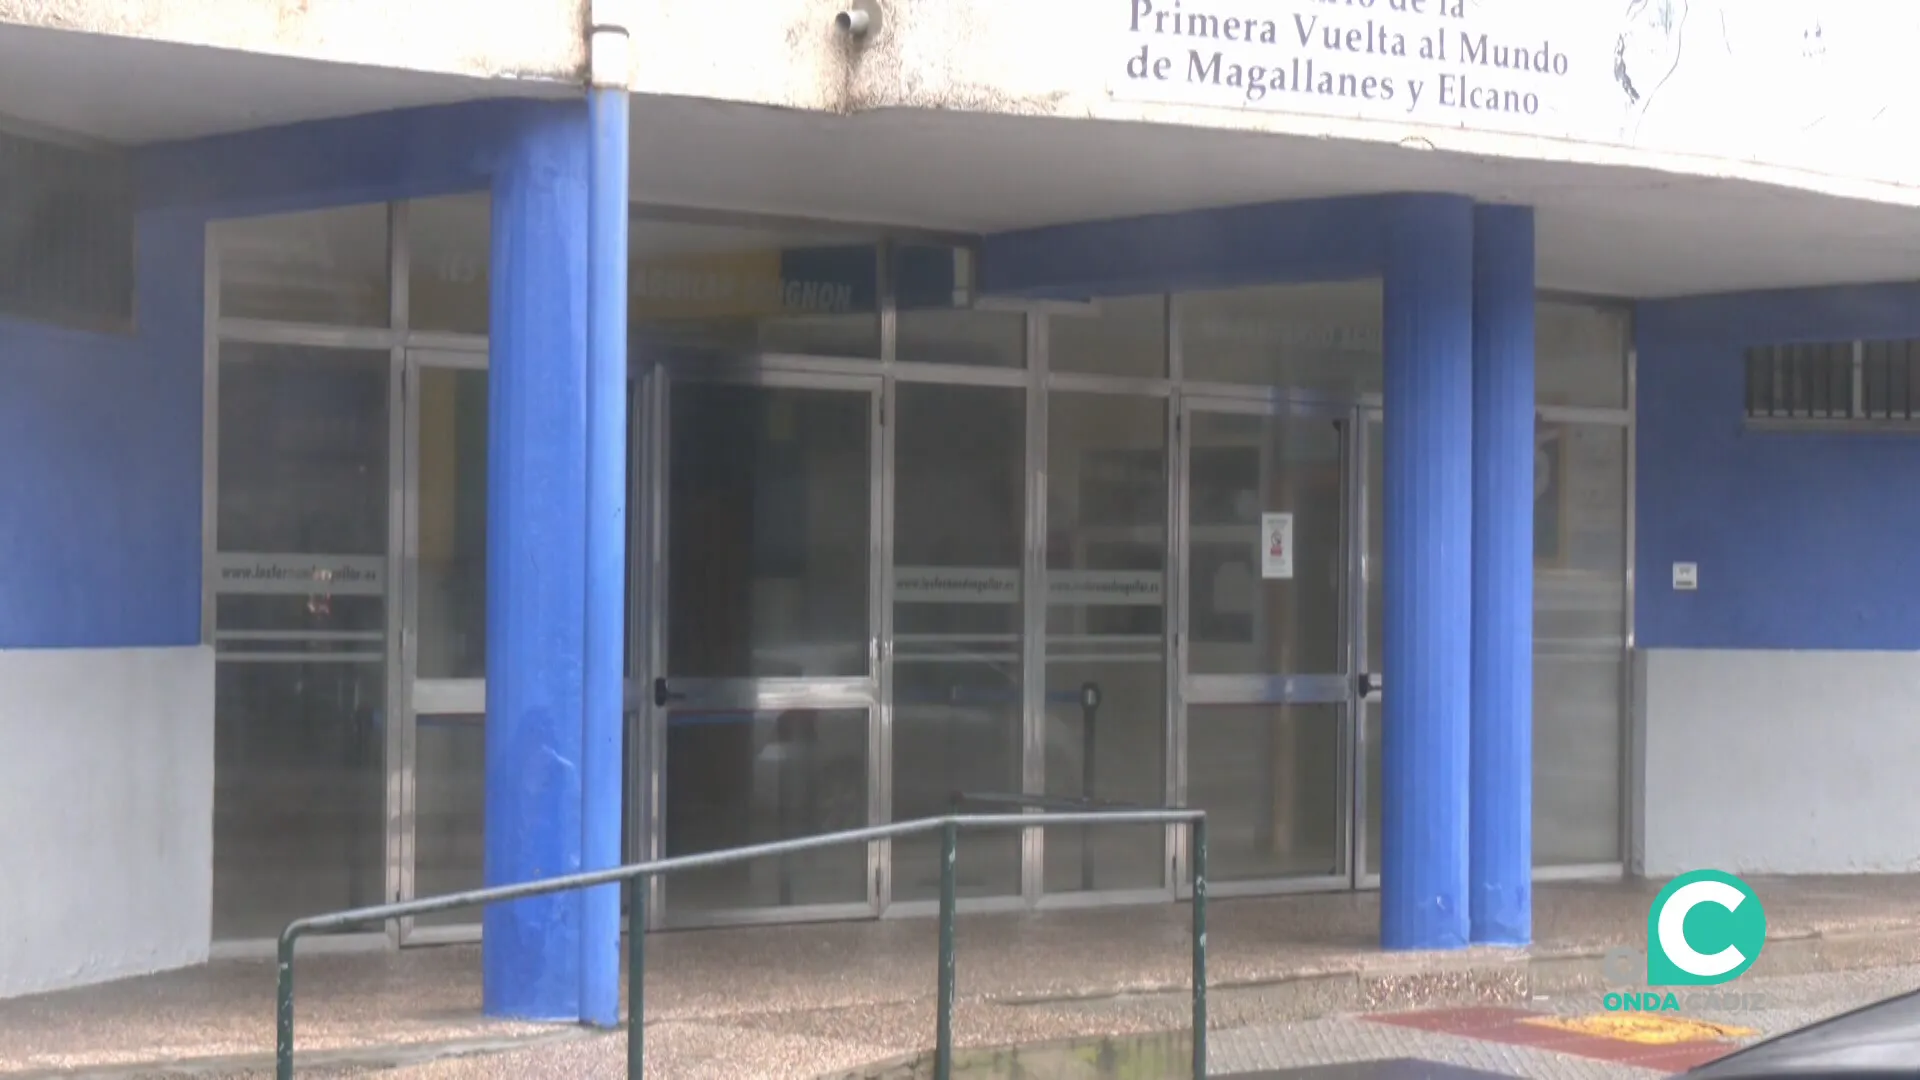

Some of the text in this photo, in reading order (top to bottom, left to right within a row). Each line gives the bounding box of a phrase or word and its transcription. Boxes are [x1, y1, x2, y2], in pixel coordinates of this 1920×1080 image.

[1129, 0, 1569, 76] Primera Vuelta al Mundo
[1126, 45, 1539, 115] de Magallanes y Elcano
